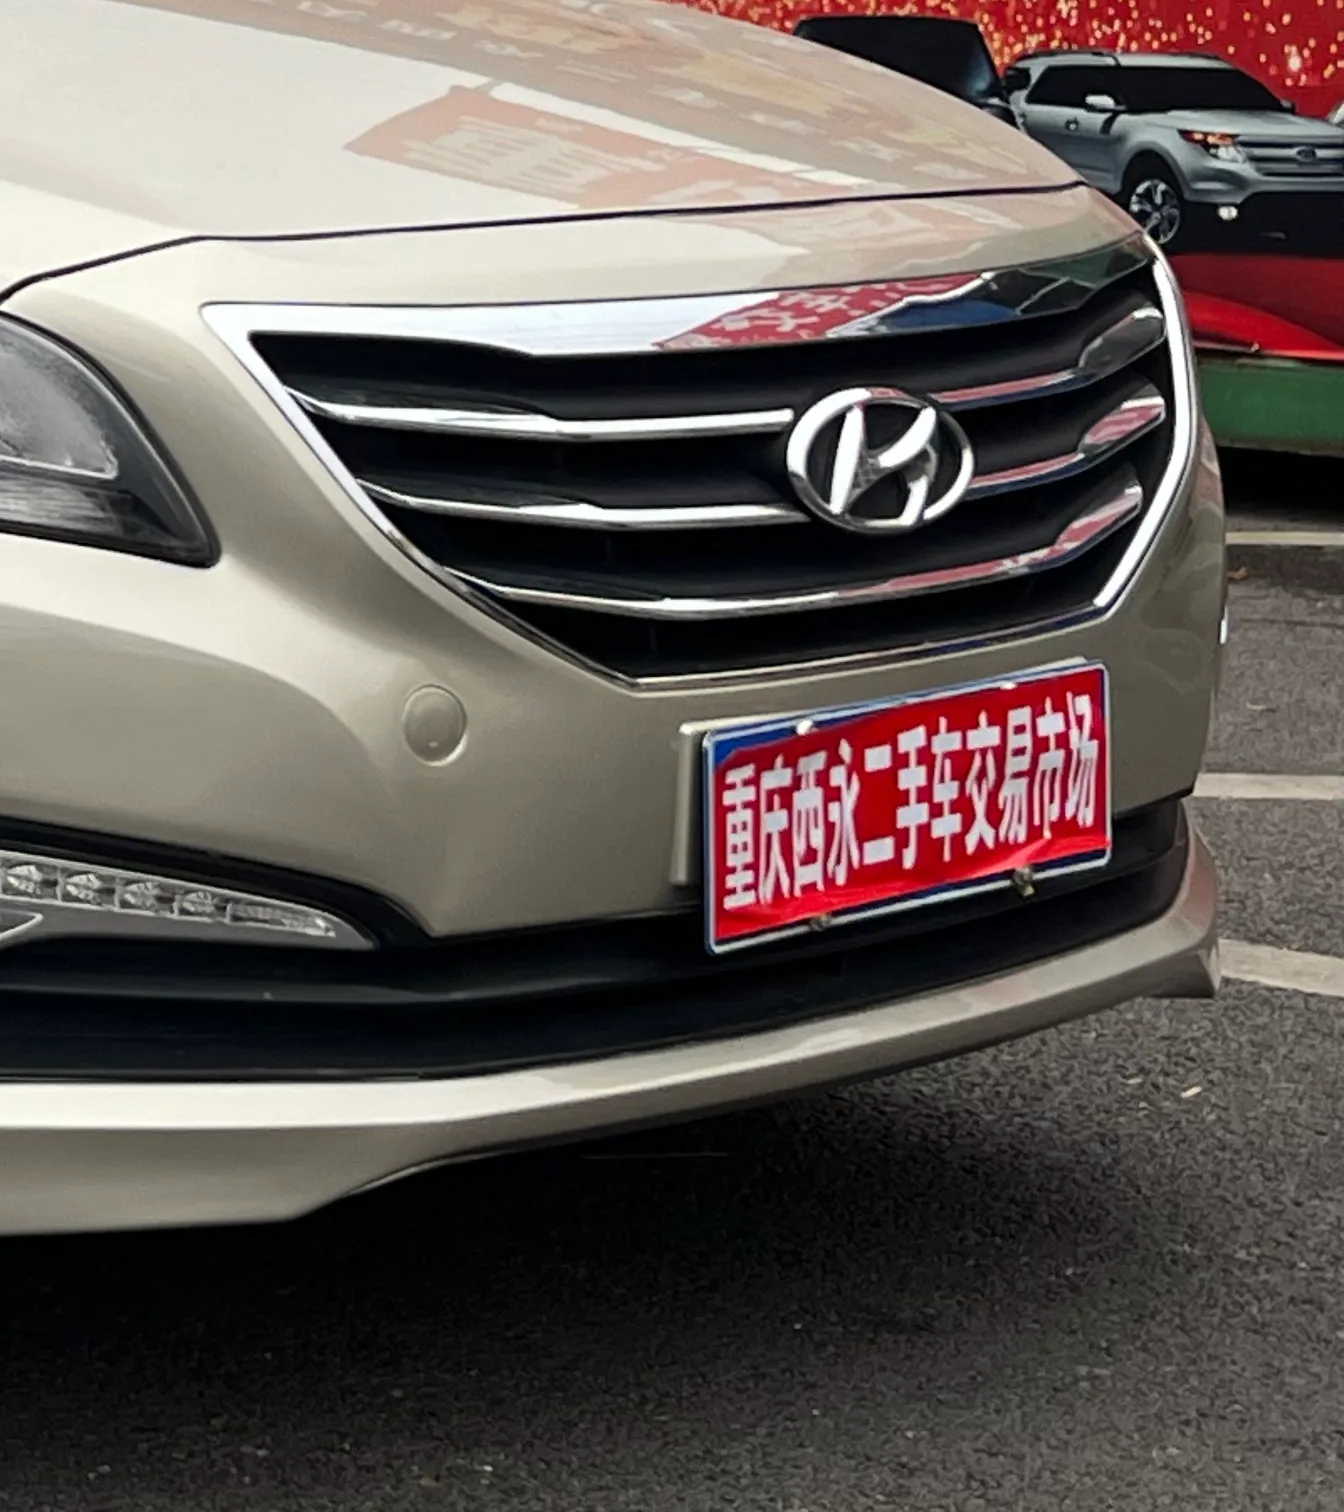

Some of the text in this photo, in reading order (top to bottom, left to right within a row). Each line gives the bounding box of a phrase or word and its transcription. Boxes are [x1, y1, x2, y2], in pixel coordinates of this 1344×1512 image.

[723, 693, 1098, 908] 重庆西永二手车交易市场
